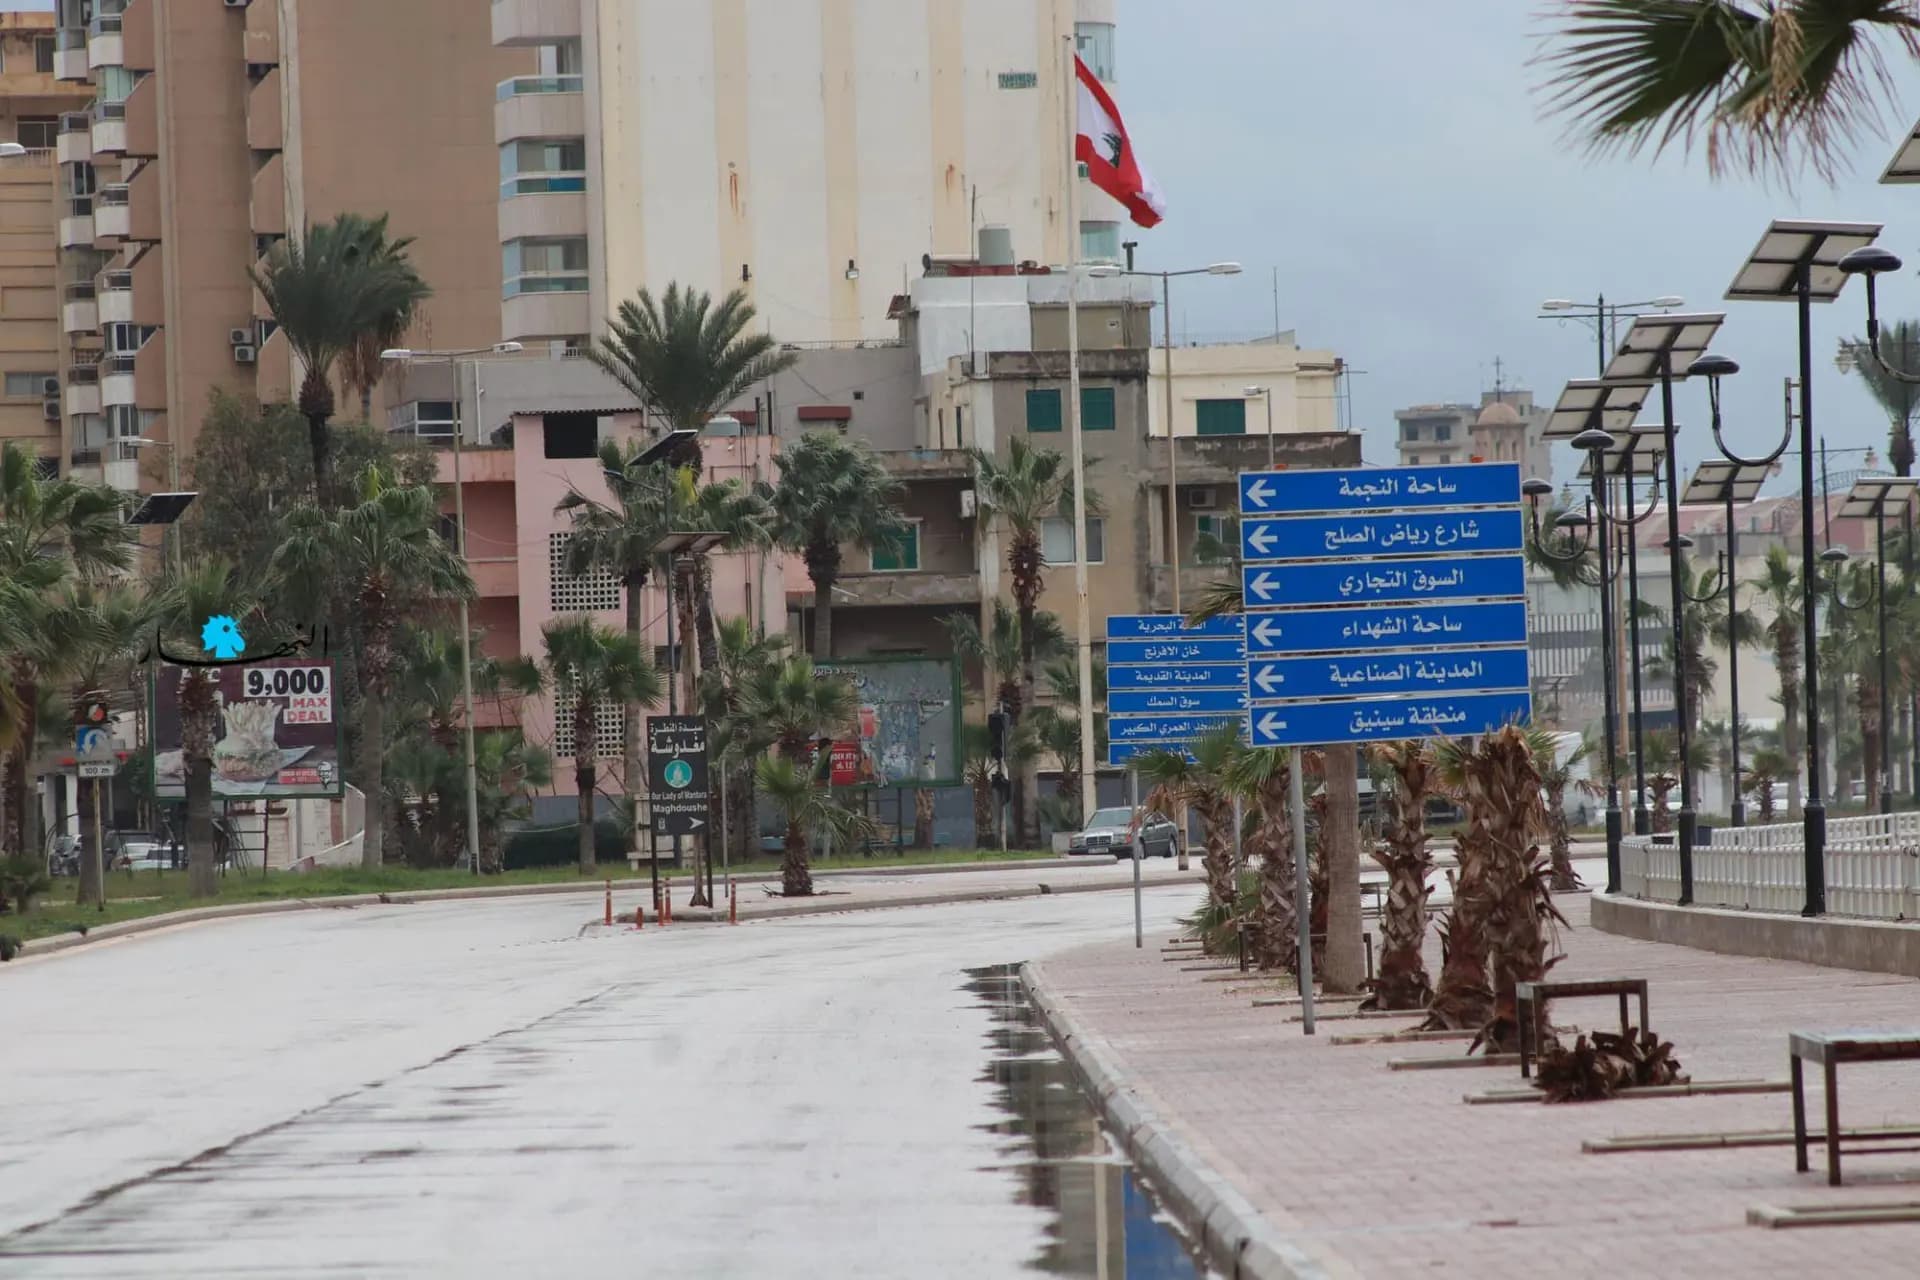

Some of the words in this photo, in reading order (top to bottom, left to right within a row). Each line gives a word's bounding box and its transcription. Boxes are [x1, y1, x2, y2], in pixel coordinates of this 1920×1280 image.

[1338, 477, 1398, 502] النجمة
[1407, 476, 1457, 494] ساحة
[1324, 525, 1376, 551] الصلح
[1381, 523, 1430, 547] رياض
[1434, 519, 1480, 546] شارع
[1338, 570, 1407, 597] التجاري
[1412, 568, 1464, 591] السوق
[1137, 619, 1176, 633] البحرية
[1342, 616, 1407, 640] الشهداء
[1412, 614, 1462, 633] ساحة
[1181, 645, 1201, 659] خان
[1135, 670, 1173, 684] القديمة
[1174, 669, 1211, 683] المدينة
[1328, 663, 1411, 688] الصناعية
[1414, 659, 1483, 680] المدينة
[248, 668, 325, 696] 9,000
[292, 697, 328, 708] MAX
[1146, 695, 1178, 707] السمك
[1179, 695, 1201, 709] سوق
[286, 710, 327, 723] DEAL
[1349, 709, 1405, 734] سينيق
[1407, 705, 1467, 725] منطقة
[1120, 722, 1157, 736] الكبير
[1158, 722, 1191, 736] العمري
[650, 735, 706, 759] مغدوشة
[652, 803, 708, 814] Maghdoushe
